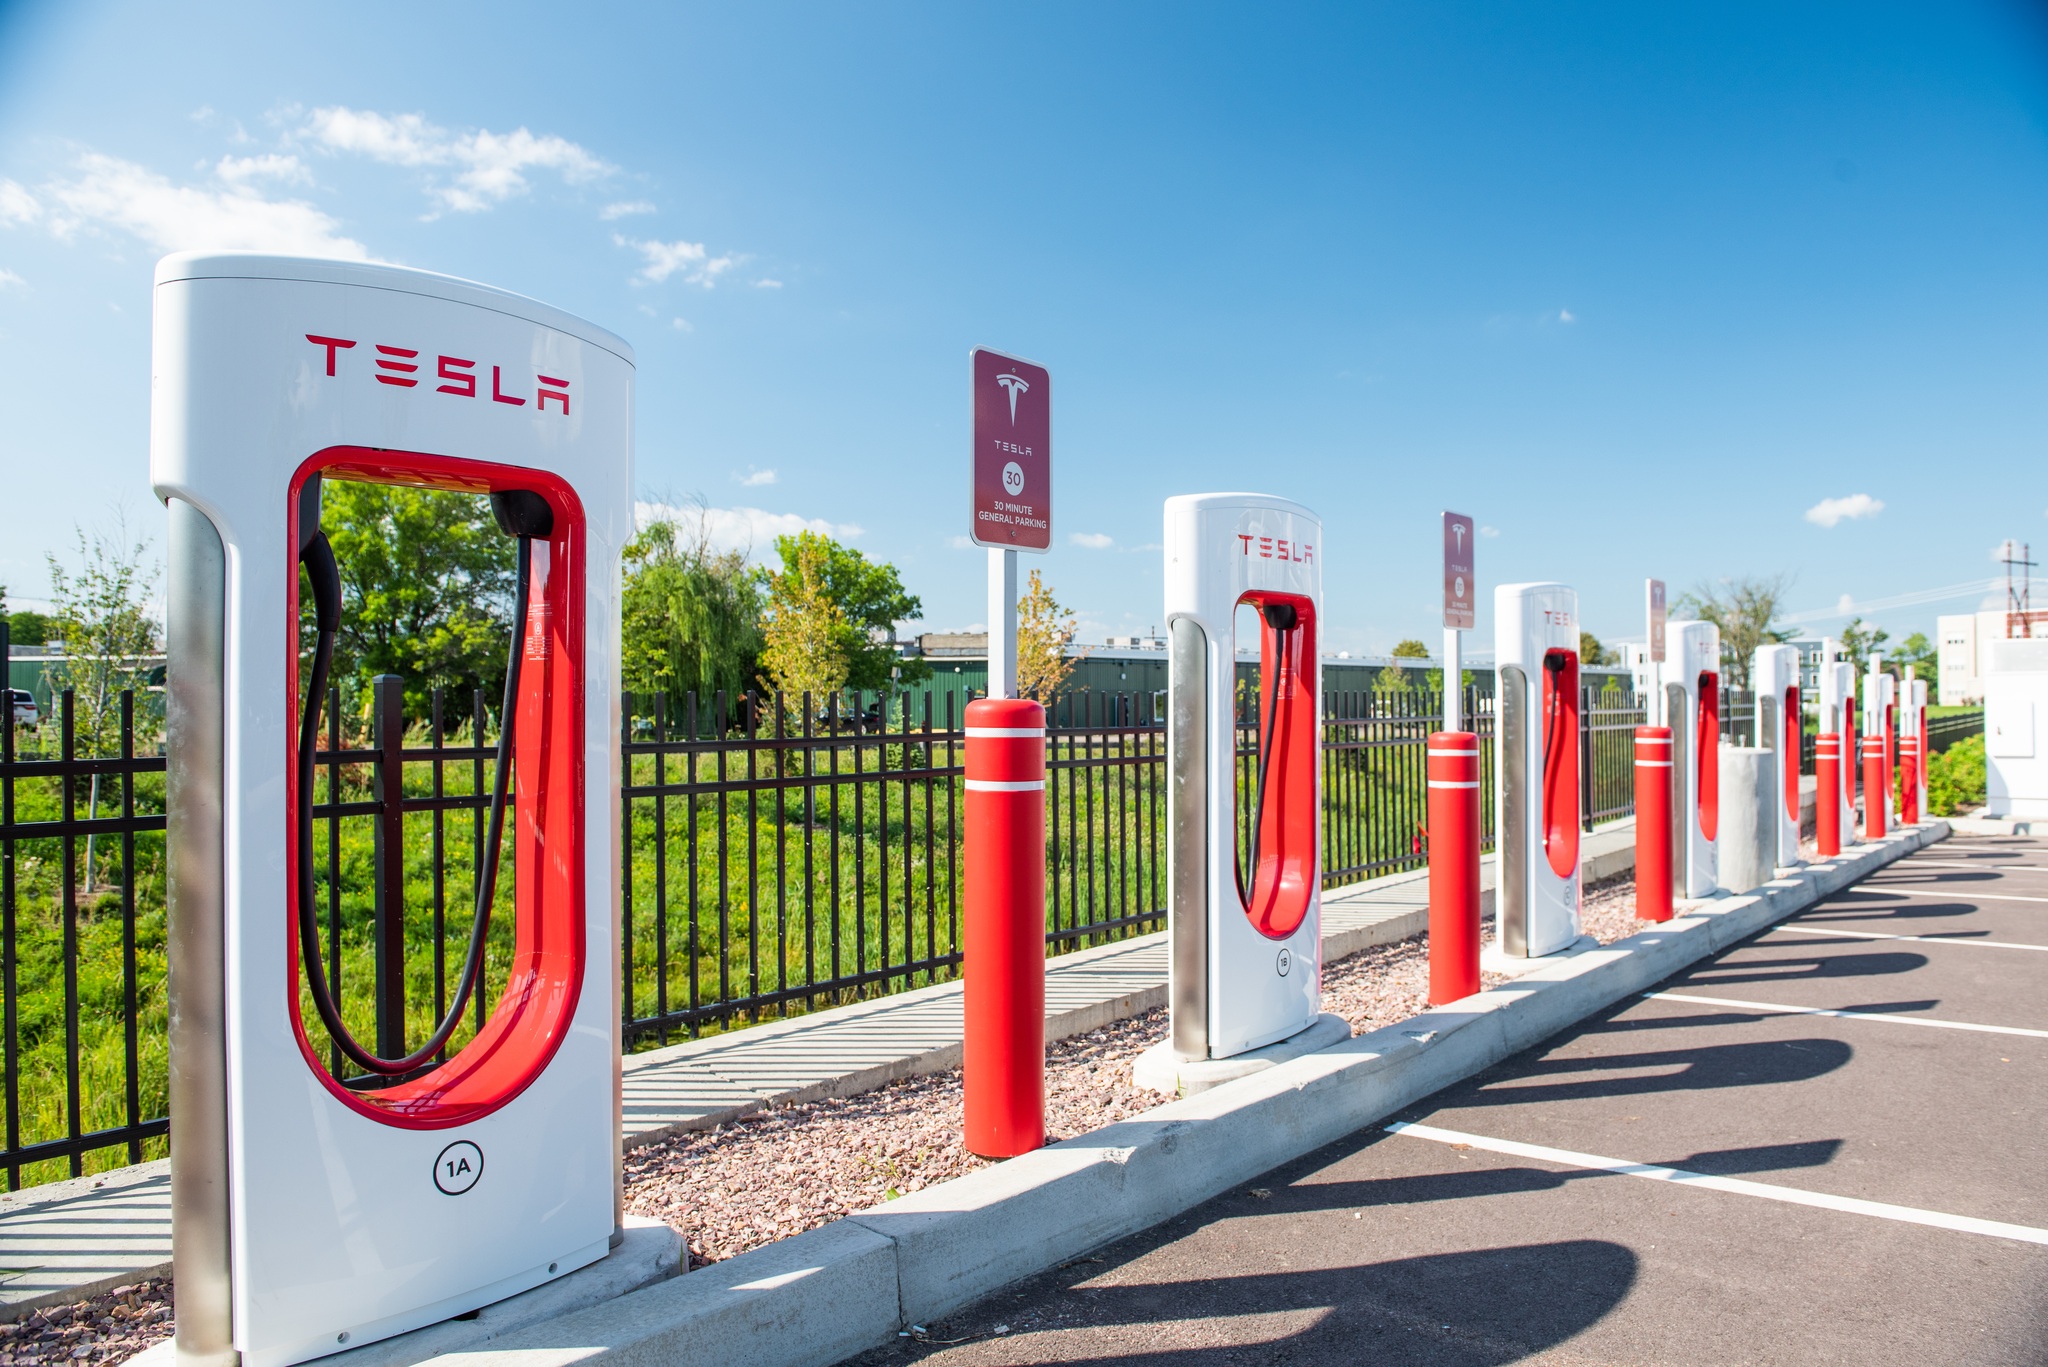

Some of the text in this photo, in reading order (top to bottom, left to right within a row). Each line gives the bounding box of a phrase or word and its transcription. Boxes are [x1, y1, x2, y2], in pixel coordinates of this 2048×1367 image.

[305, 334, 570, 416] TESLA
[994, 440, 1032, 457] TESLA
[1006, 471, 1021, 486] 30
[994, 500, 1033, 516] 30 MINUTE
[978, 510, 1047, 529] GENERAL PARKING
[1238, 534, 1313, 565] TESLA
[446, 1157, 471, 1178] 1A
